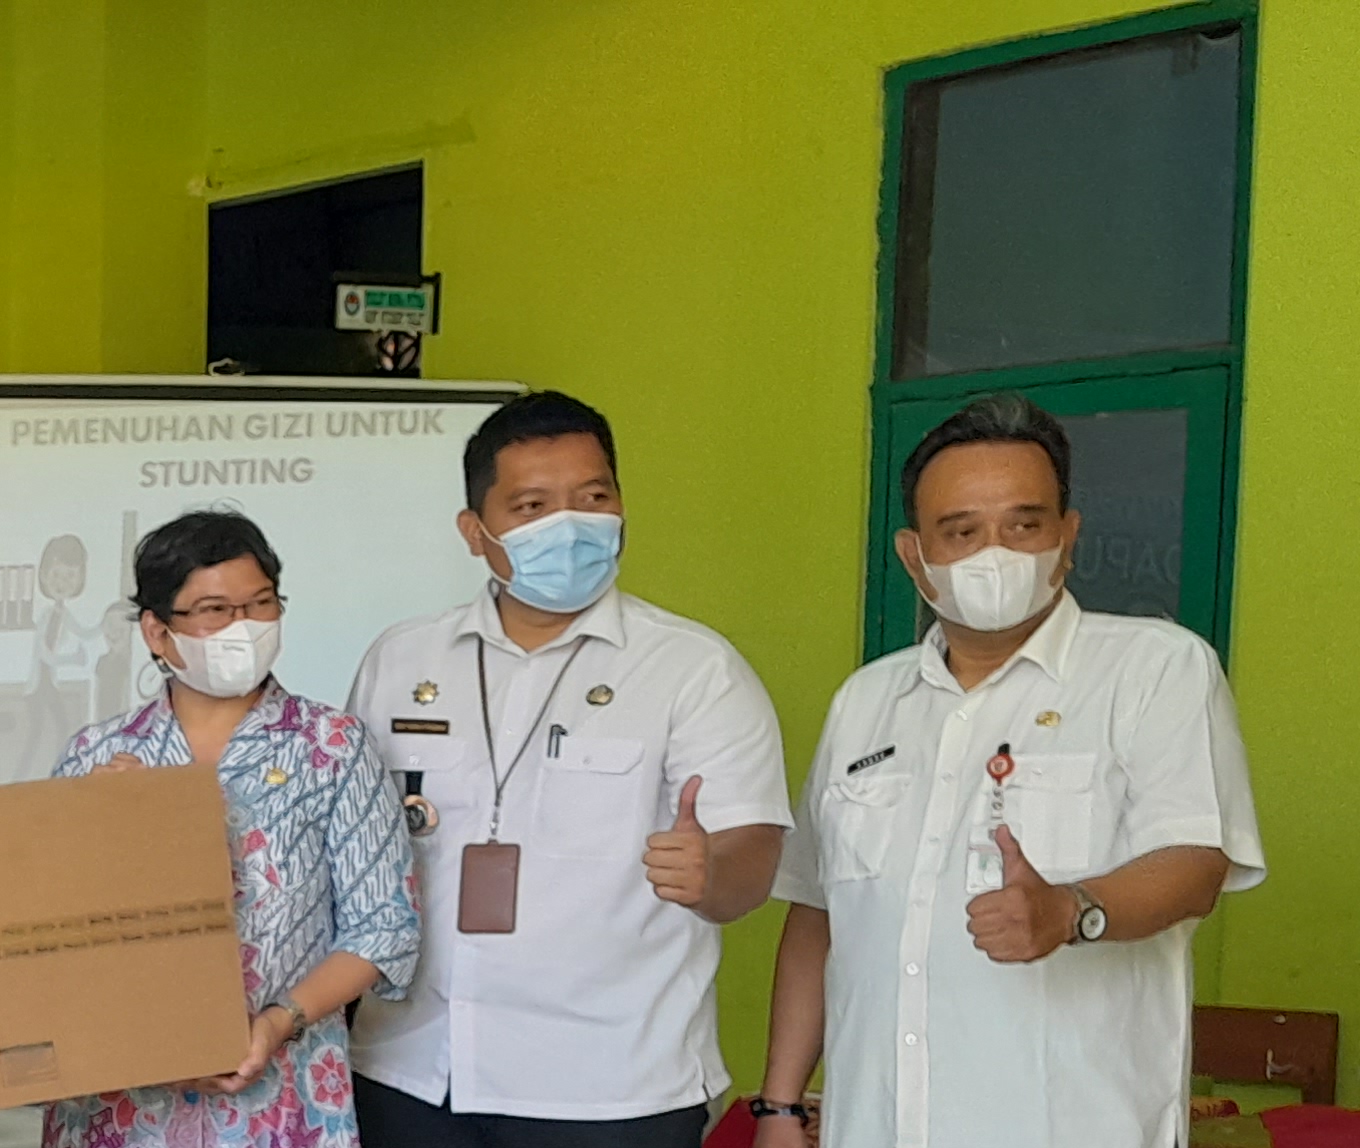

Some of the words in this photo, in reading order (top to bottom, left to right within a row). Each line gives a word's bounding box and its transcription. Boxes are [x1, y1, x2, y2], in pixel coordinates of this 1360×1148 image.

[11, 414, 234, 447] PEMENUHAN
[243, 412, 314, 440] GIZI
[325, 408, 444, 438] UNTUK
[138, 456, 315, 489] STUNTING
